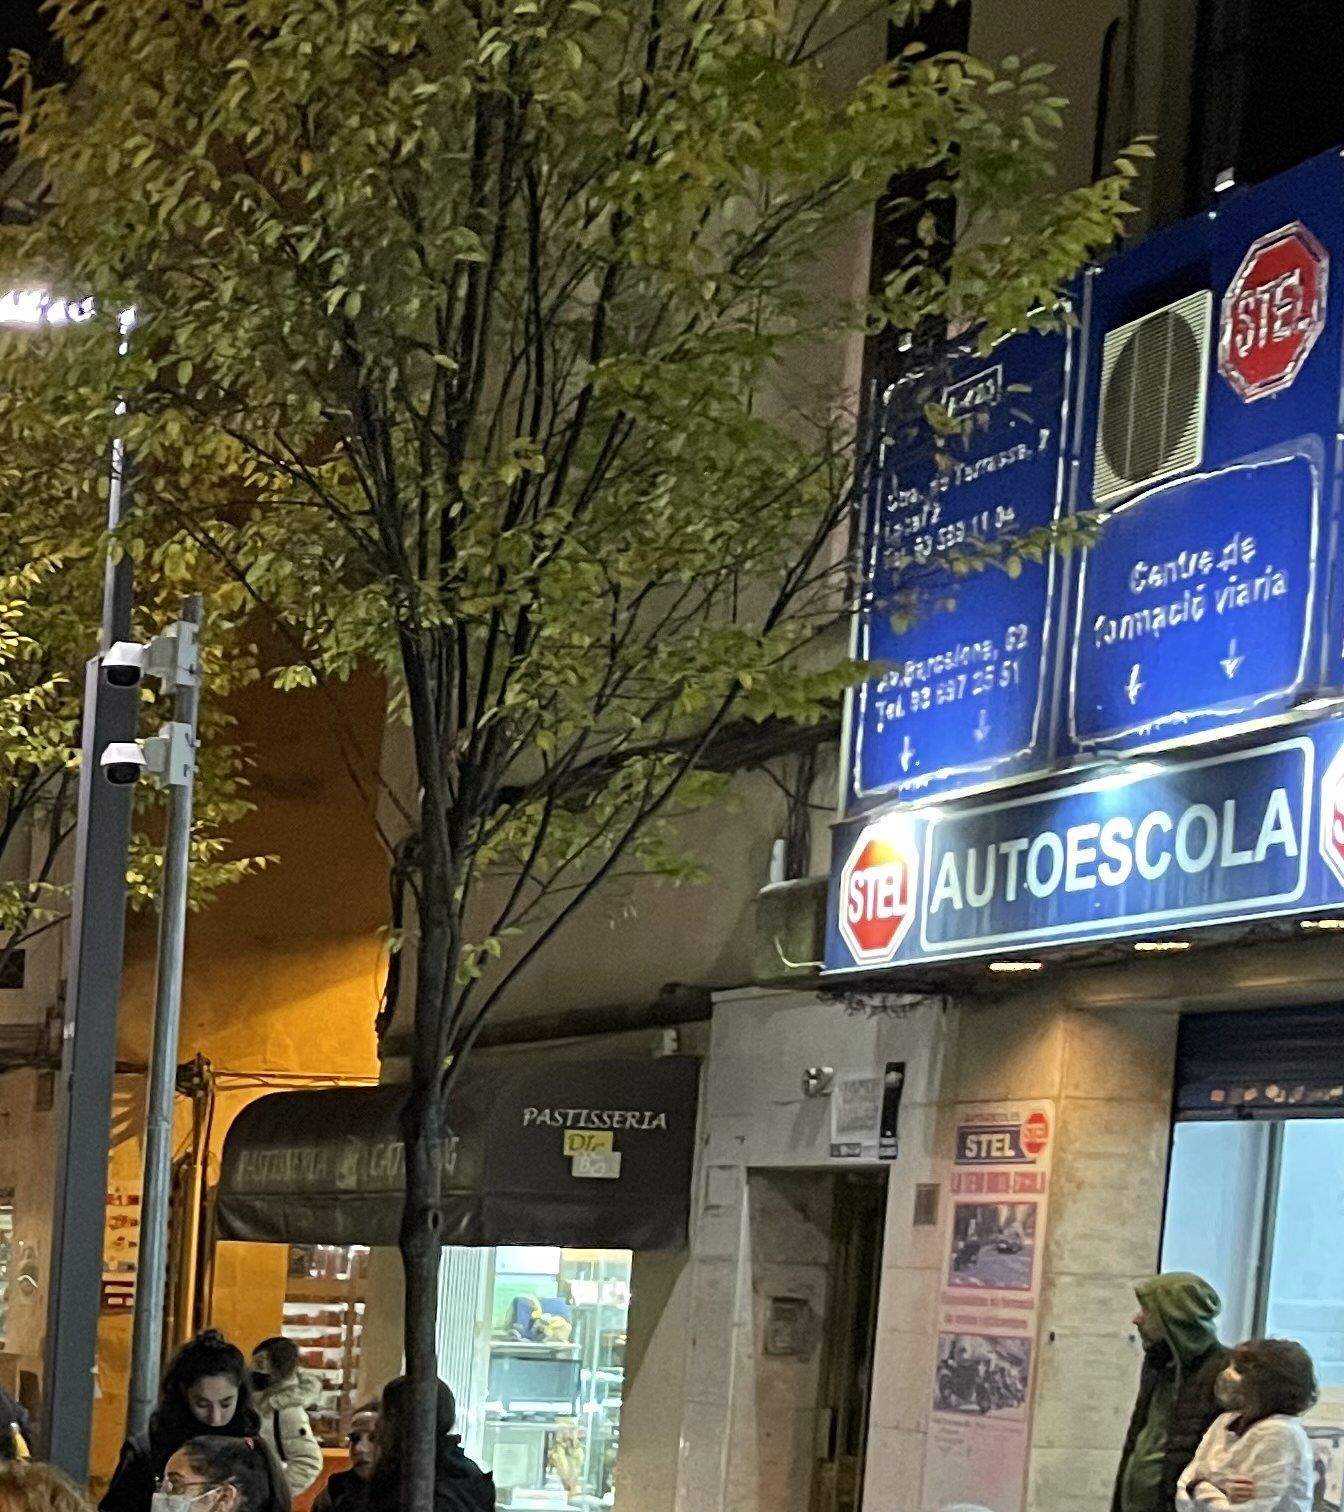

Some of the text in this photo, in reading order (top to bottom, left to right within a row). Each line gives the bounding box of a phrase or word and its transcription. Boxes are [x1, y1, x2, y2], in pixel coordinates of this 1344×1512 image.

[1235, 267, 1312, 358] STEL
[928, 787, 1299, 915] AUTOESCOLA
[847, 862, 911, 924] STEL
[522, 1107, 668, 1130] PASTISSERIA
[964, 1132, 1016, 1158] STEL
